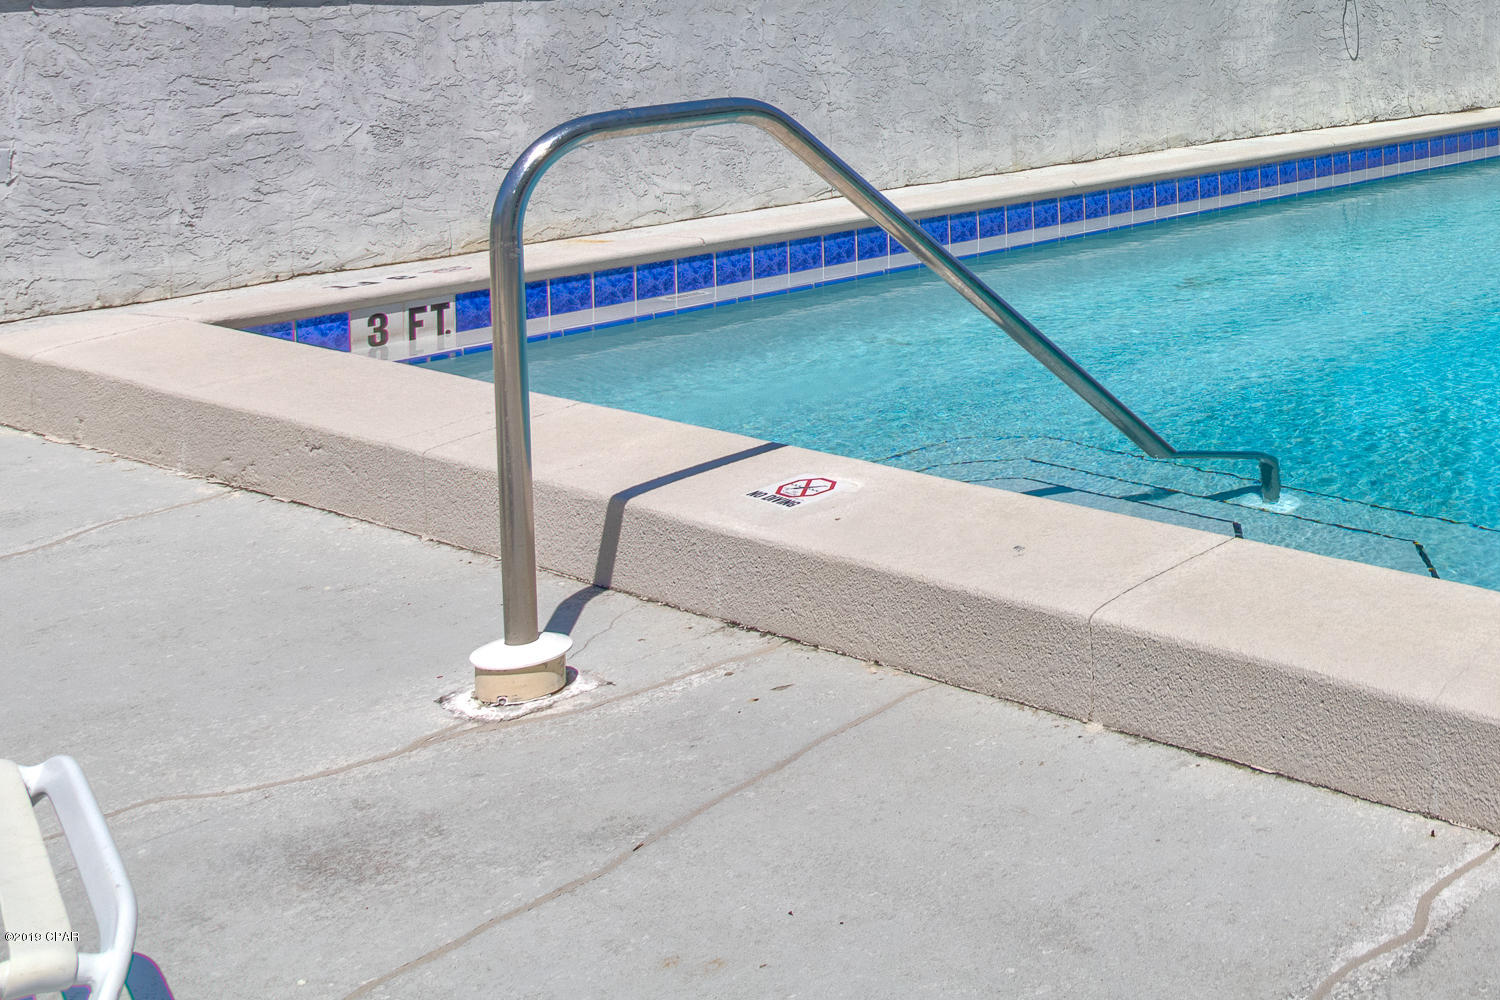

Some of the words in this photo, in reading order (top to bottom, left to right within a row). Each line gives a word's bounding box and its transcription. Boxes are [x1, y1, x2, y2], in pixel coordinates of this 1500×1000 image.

[368, 313, 388, 347] 3
[408, 302, 451, 341] FT.
[762, 494, 800, 507] DIVING
